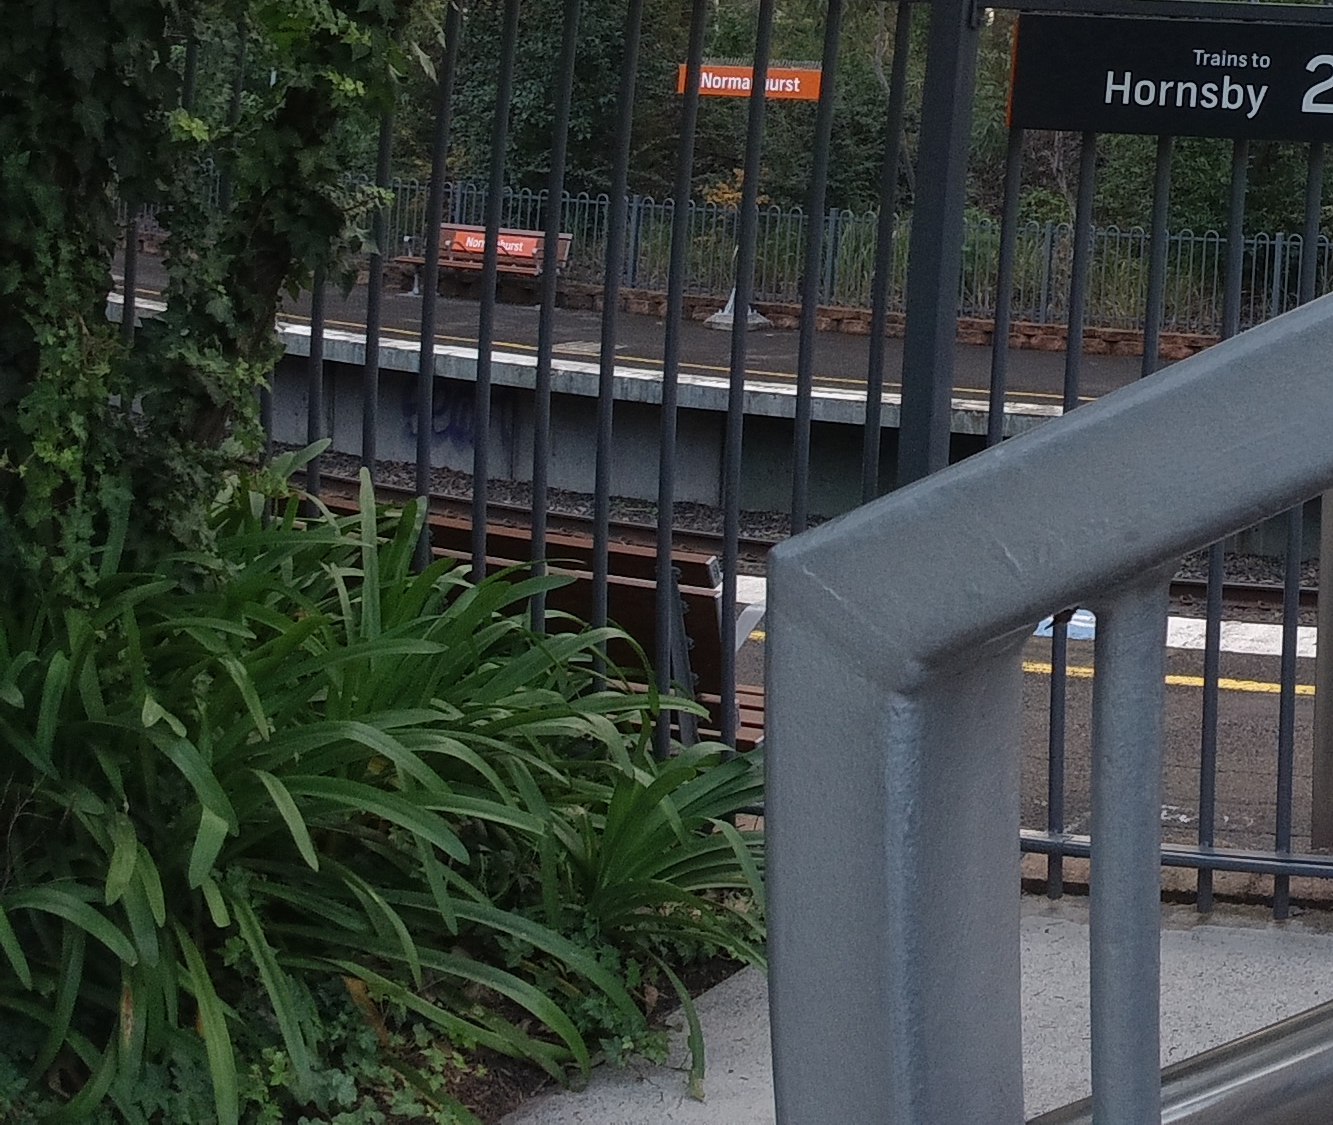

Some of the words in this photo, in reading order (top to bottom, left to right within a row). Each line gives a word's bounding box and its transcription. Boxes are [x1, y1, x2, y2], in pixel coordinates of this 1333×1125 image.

[1192, 49, 1248, 68] Trains
[1251, 53, 1271, 69] to
[701, 72, 801, 92] Normaurst
[1104, 70, 1269, 119] Hornsby
